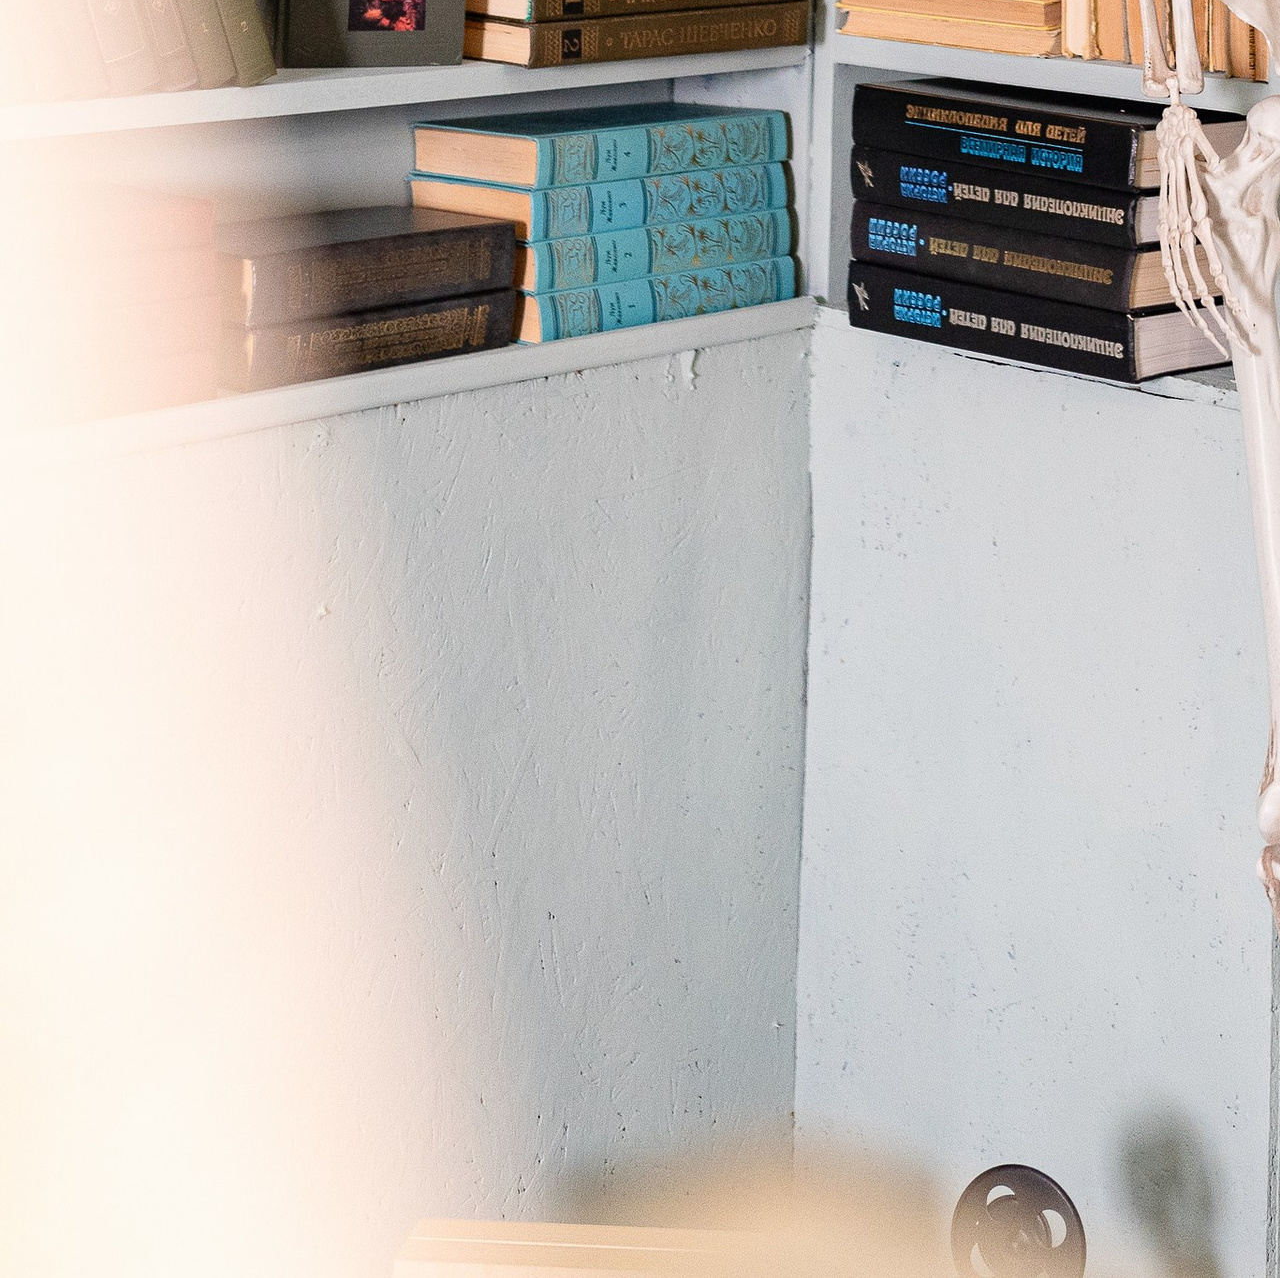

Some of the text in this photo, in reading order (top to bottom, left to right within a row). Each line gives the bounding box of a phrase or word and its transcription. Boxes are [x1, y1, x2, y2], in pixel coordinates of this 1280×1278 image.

[563, 37, 580, 52] 2
[620, 19, 778, 50] ТАРАС ШЕВЧЕНКО
[906, 103, 1087, 144] ЭНЦИКЛОПЕДИЯ ДЛЯ ДЕТЕЙ
[960, 135, 1084, 173] ВСЕМИРНАЯ ИСТОРИЯ
[900, 165, 947, 187] РОССИИ
[900, 182, 947, 204] ИСТОРИЯ
[953, 182, 1124, 226] ЭНЦИКЛОПЕДИЯ ДЛЯ ДЕТЕЙ
[869, 217, 918, 240] РОССИИ
[869, 234, 917, 256] ИСТОРИЯ
[929, 236, 1114, 285] ЭНЦИКЛОПЕДИЯ ДЛЯ ДЕТЕЙ
[894, 288, 942, 311] РОССИИ
[894, 305, 942, 329] ИСТОРИЯ
[949, 308, 1124, 359] ЭНЦИКЛОПЕДИЯ ДЛЯ ДЕТЕЙ
